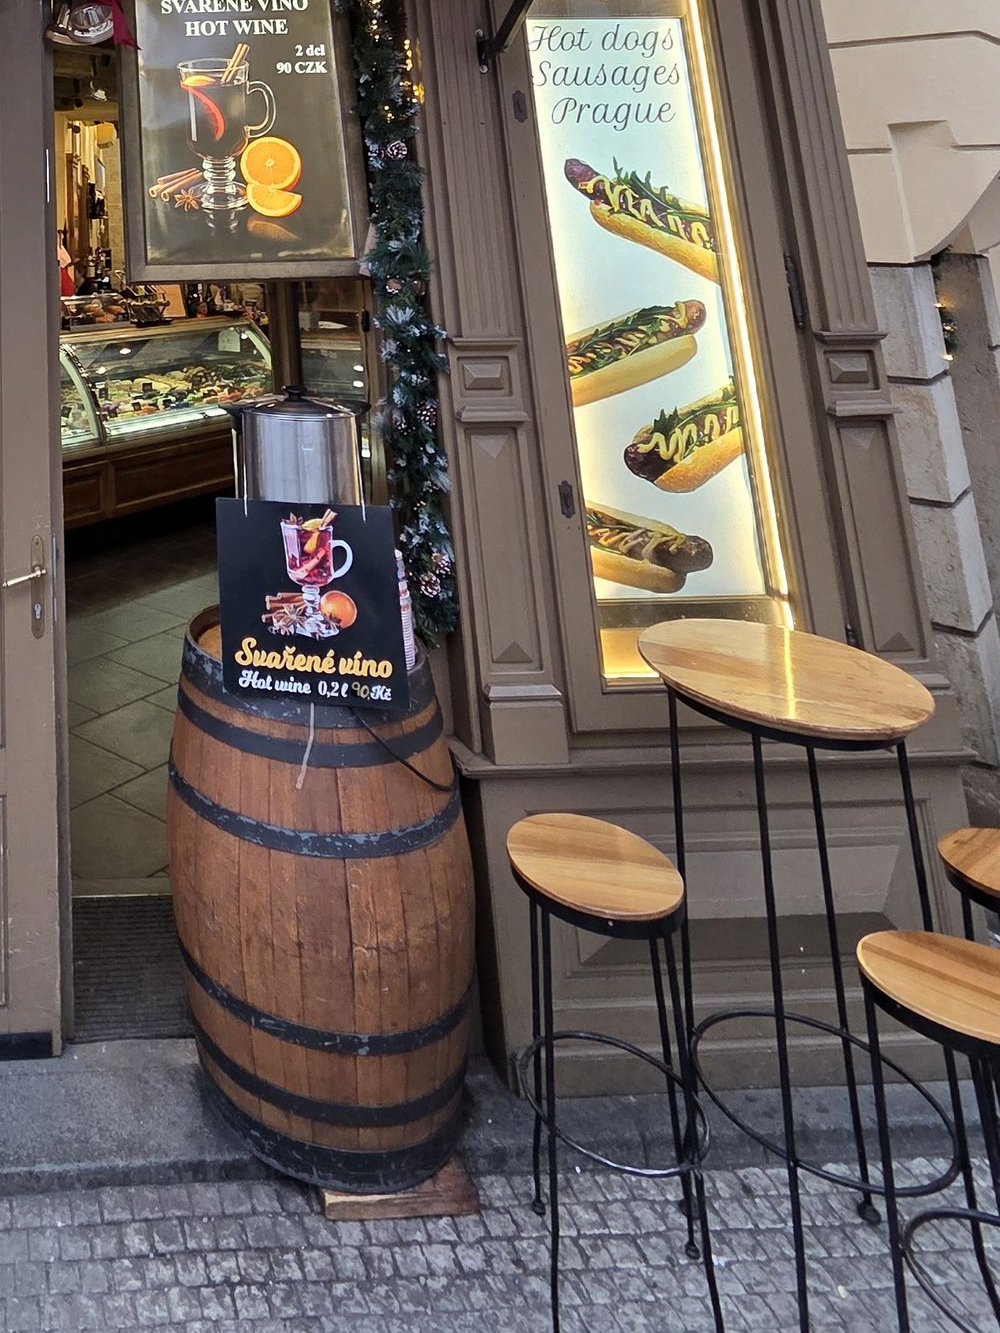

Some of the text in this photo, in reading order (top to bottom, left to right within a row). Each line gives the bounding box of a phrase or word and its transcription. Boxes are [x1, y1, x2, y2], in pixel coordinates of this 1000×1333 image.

[184, 19, 288, 36] HOT WINE
[529, 23, 674, 59] Hot dogs
[294, 44, 303, 57] 2
[275, 61, 328, 74] 90 CZK
[532, 60, 681, 94] Sausages
[551, 97, 677, 132] Prague
[234, 637, 394, 679] Svařené víno
[238, 669, 273, 691] Hot
[275, 676, 312, 695] wine
